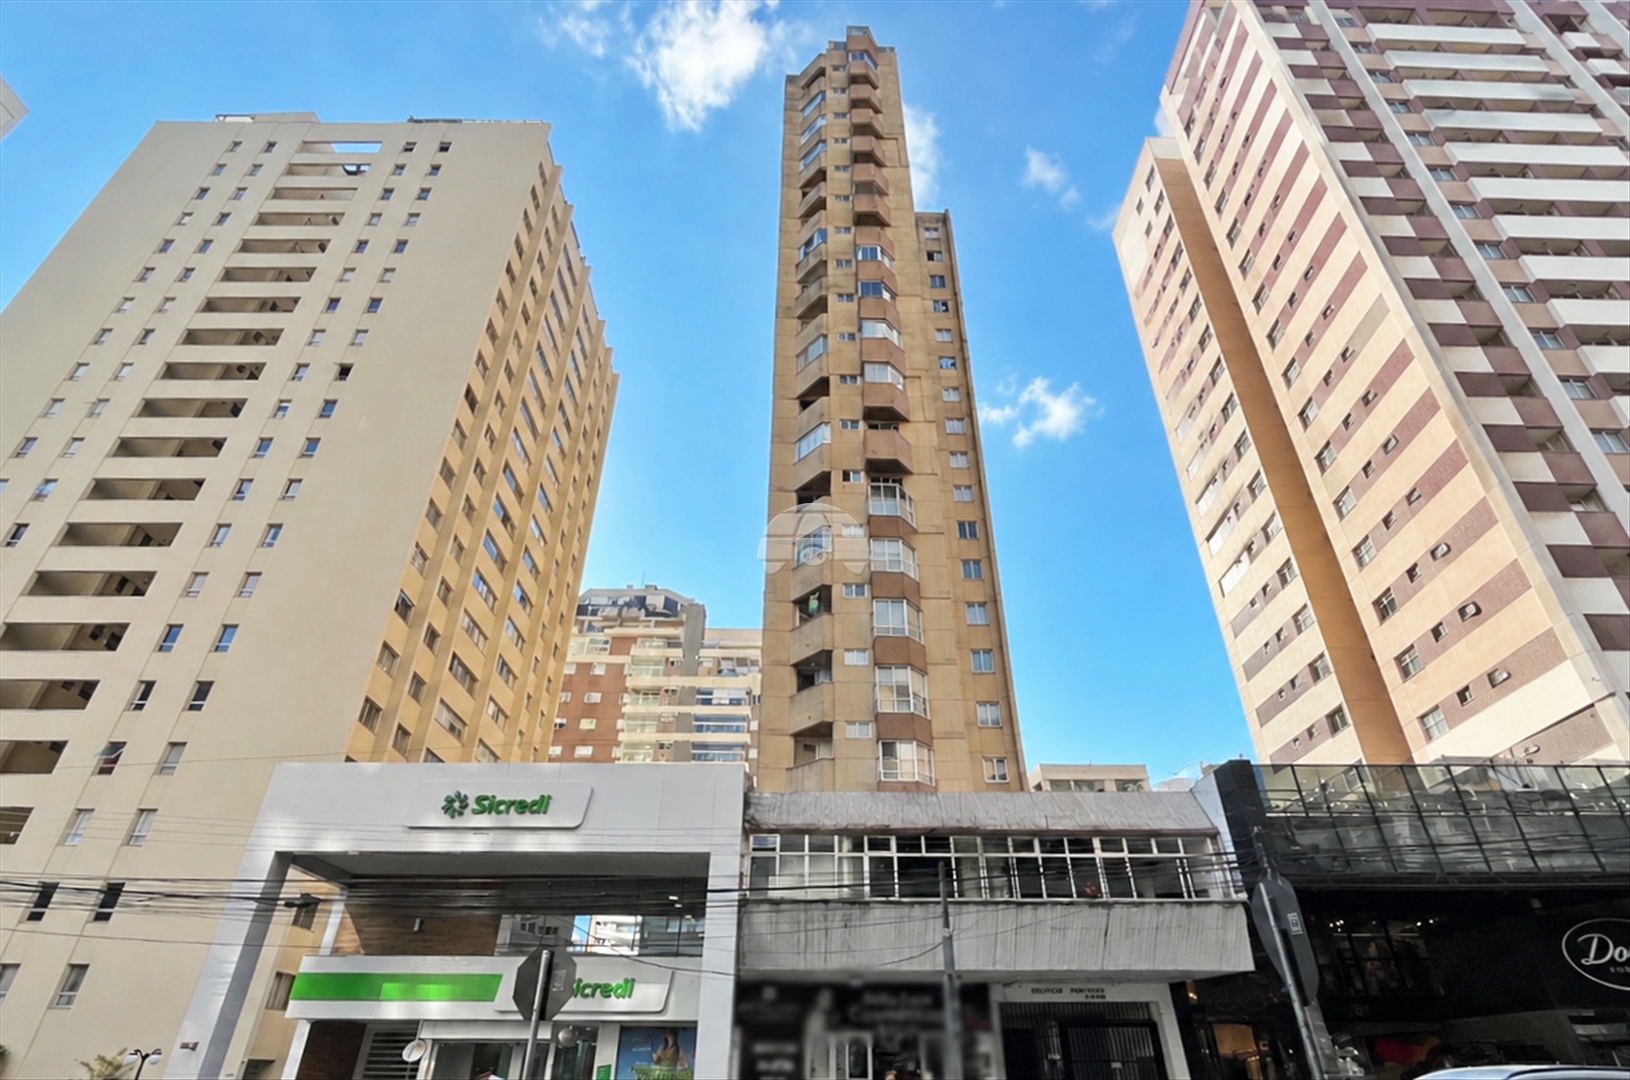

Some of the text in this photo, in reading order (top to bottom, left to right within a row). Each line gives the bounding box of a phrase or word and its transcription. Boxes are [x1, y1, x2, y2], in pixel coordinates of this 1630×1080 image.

[471, 794, 553, 815] Sicredi
[1577, 933, 1630, 965] Do
[573, 977, 636, 999] icredi
